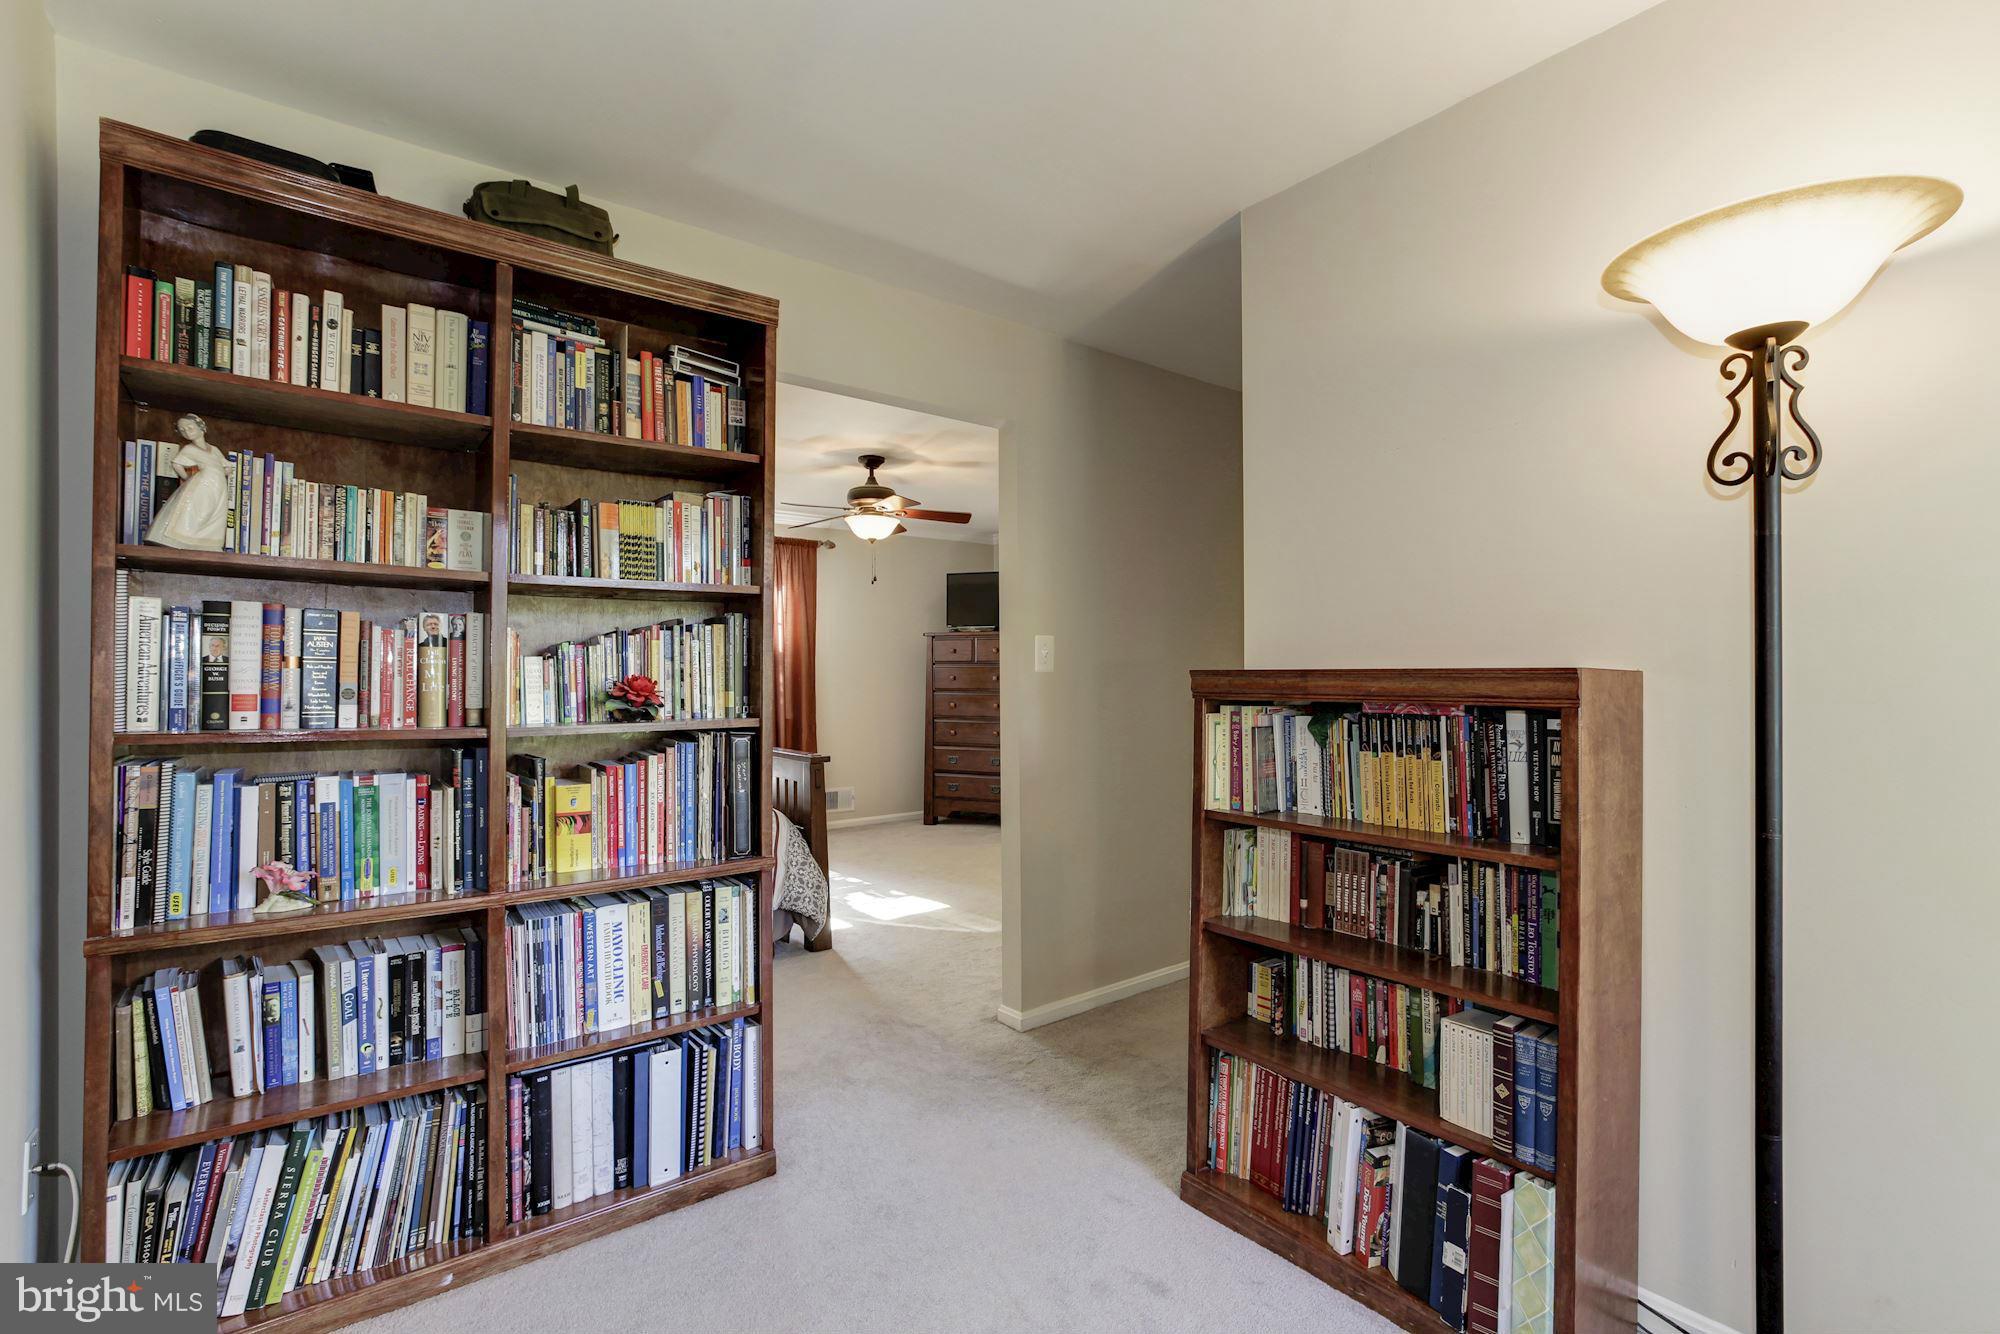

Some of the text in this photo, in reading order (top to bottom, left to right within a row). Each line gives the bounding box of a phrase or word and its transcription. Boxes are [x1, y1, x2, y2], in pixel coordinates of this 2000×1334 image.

[239, 286, 247, 334] LETHAL WARRIORS
[257, 318, 268, 344] SECRETS
[327, 332, 337, 368] WICKED
[655, 366, 663, 396] THE PARTY
[140, 473, 150, 530] THE JUNGLE
[269, 625, 282, 692] TOM BROKAW
[306, 641, 334, 649] AUSTEN
[135, 614, 159, 716] American Adventures
[174, 657, 184, 687] OFFICER'S
[405, 647, 416, 712] REAL CHANGE
[576, 656, 584, 683] Vietnam
[173, 688, 183, 707] GUIDE
[1494, 723, 1504, 749] Paradise
[1496, 749, 1503, 758] OF
[1487, 723, 1497, 787] NATURAL WONDERS
[1532, 749, 1540, 785] VIETNAM,
[657, 793, 664, 803] DO
[1497, 773, 1507, 800] BLIND
[198, 788, 210, 830] PARENTING
[279, 800, 292, 856] Financial Management
[417, 798, 426, 865] TRADING LIVING
[300, 836, 308, 862] MANAGEMENT
[140, 849, 152, 886] Style Guide
[172, 895, 180, 913] USED
[586, 922, 595, 979] WESTERN ART
[603, 922, 611, 949] FAMILY
[655, 924, 666, 982] Molecular Cell Biology
[671, 916, 679, 980] HUMAN ANATOMY
[691, 912, 700, 992] HUMAN PHYSIOLOGY
[704, 895, 712, 980] COLOR ATLAS OF ANATOMY
[721, 929, 730, 971] BIOLOGY
[1527, 921, 1537, 975] LEO TOLSTOY
[611, 921, 625, 1003] MAYO CLINIC
[641, 944, 649, 991] EMERGENCY CARE
[343, 970, 354, 1020] THE GOAL
[360, 968, 370, 1002] Literature
[411, 992, 421, 1008] Beirut
[453, 988, 461, 1018] PALACE
[604, 981, 612, 1006] BOOK
[445, 990, 453, 1019] FILE
[408, 1013, 421, 1036] Jerusalem
[732, 1043, 742, 1072] BODY
[214, 1148, 227, 1174] VIETNAM
[194, 1161, 212, 1204] EVEREST
[144, 1201, 156, 1233] NASA
[244, 1187, 273, 1270] Masterclass in Photography
[261, 1166, 296, 1267] SIERRA CLUB
[1359, 1186, 1370, 1255] Do-It-Yourself
